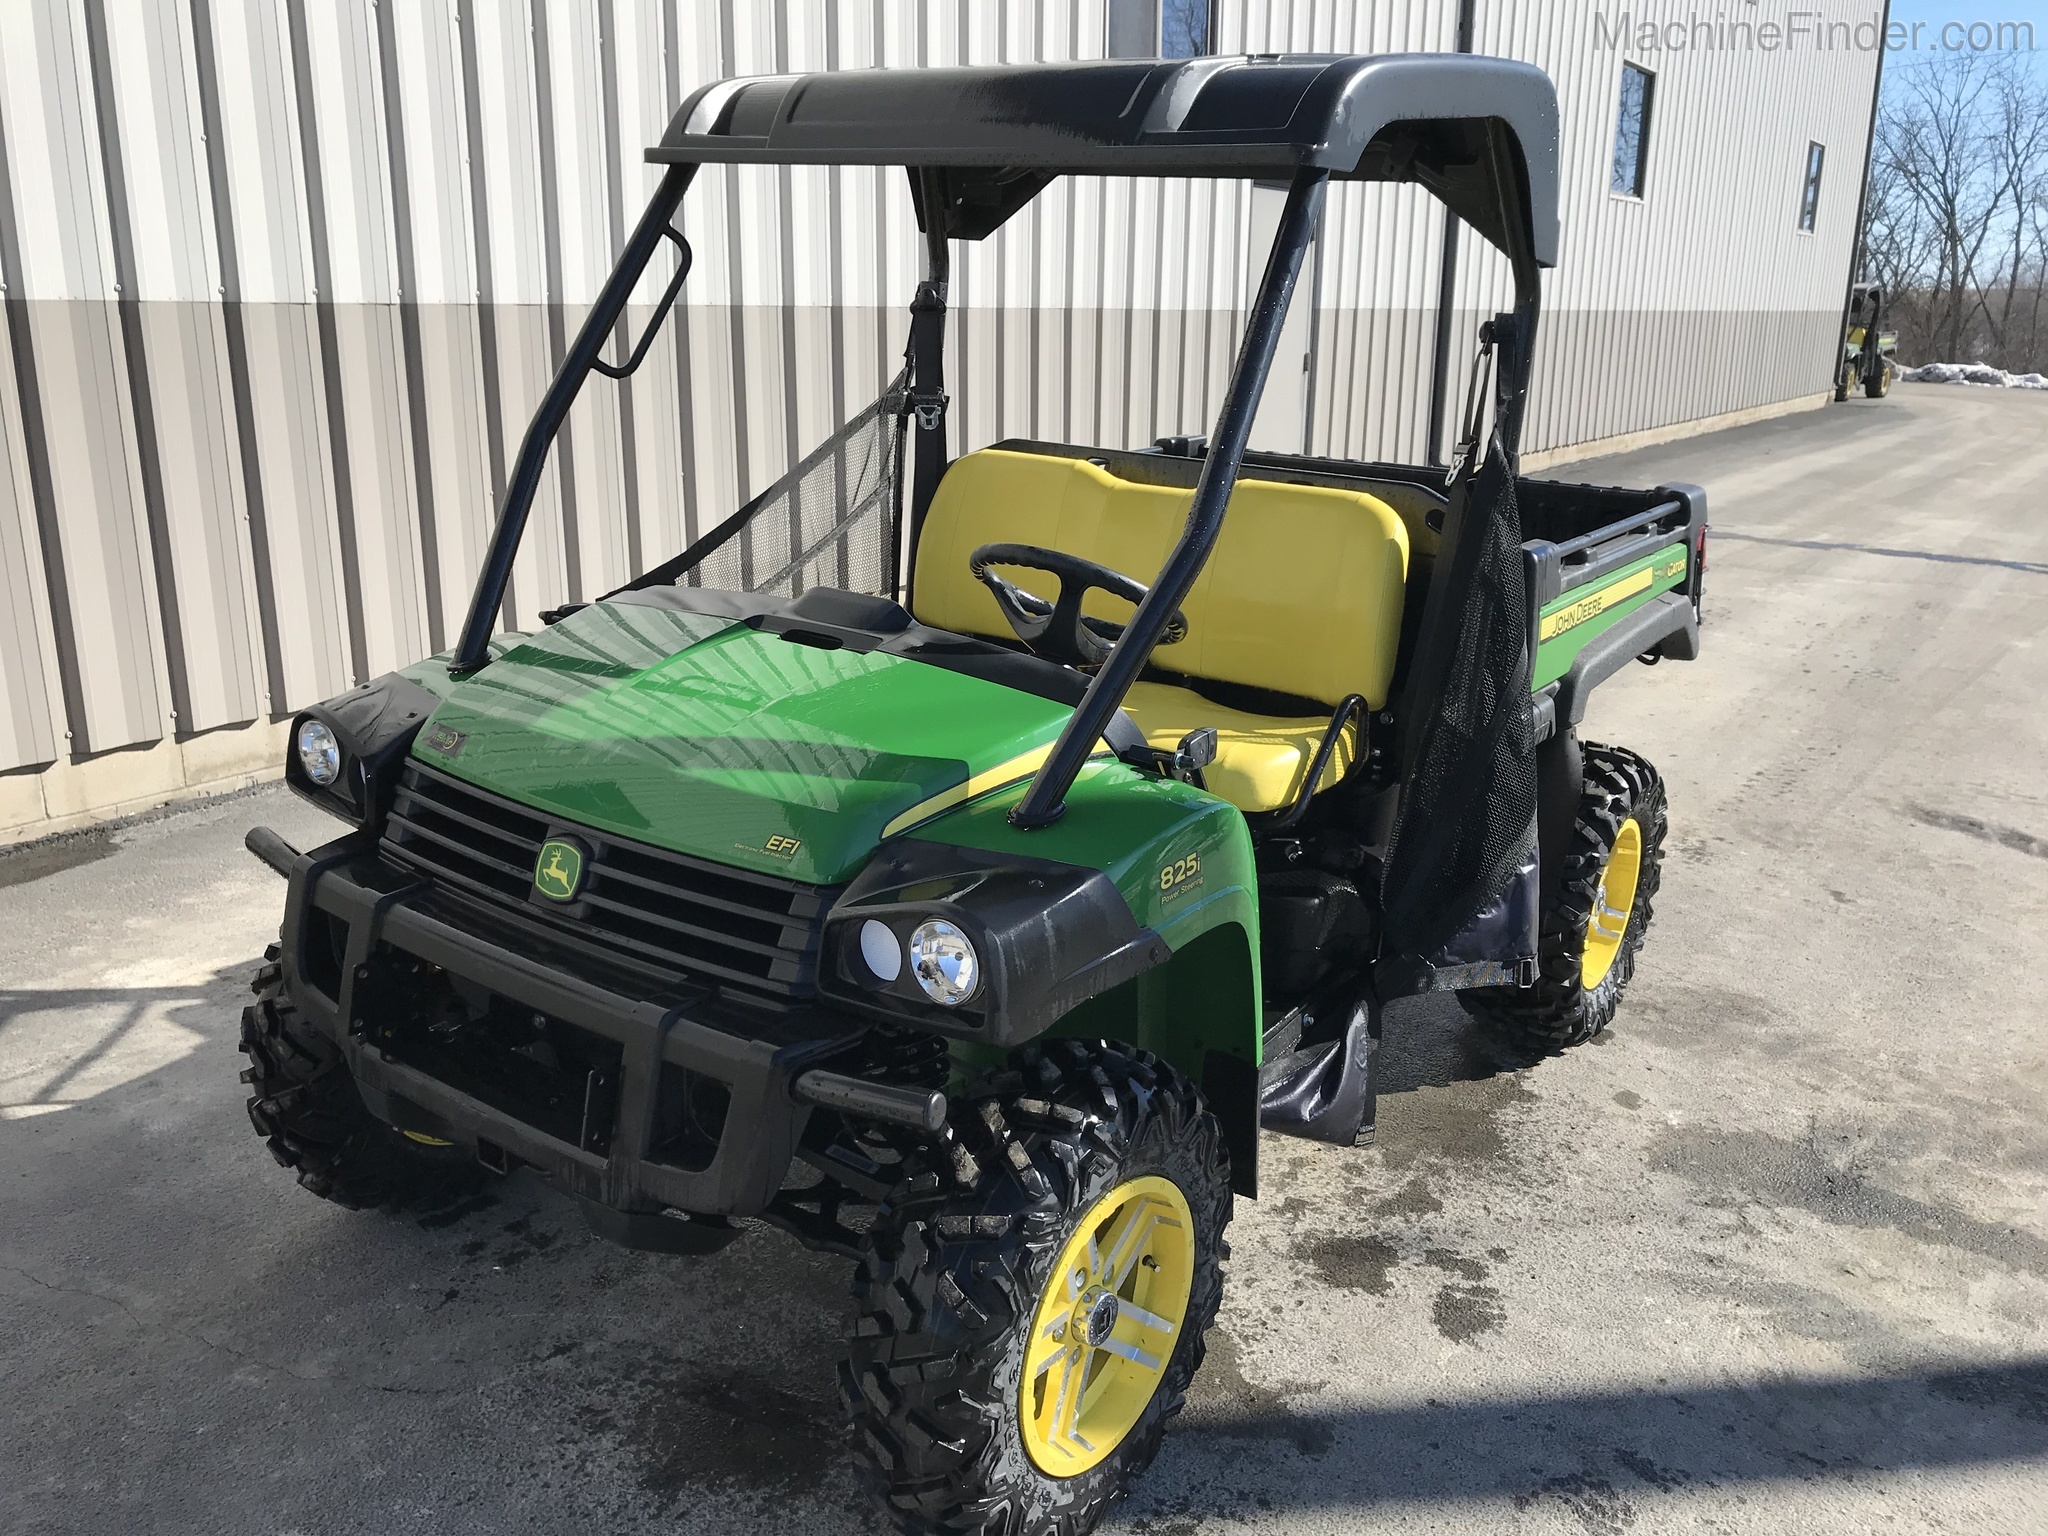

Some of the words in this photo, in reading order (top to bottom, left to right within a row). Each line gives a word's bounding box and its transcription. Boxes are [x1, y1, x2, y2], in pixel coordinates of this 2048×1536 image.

[1667, 559, 1686, 577] GATOR
[1552, 610, 1577, 637] JOHN
[1576, 597, 1603, 624] DEERE
[759, 848, 770, 856] Fuel
[765, 834, 801, 855] EFI
[1160, 852, 1201, 890] 825i
[1161, 888, 1180, 905] Power
[1181, 876, 1204, 894] Steering
